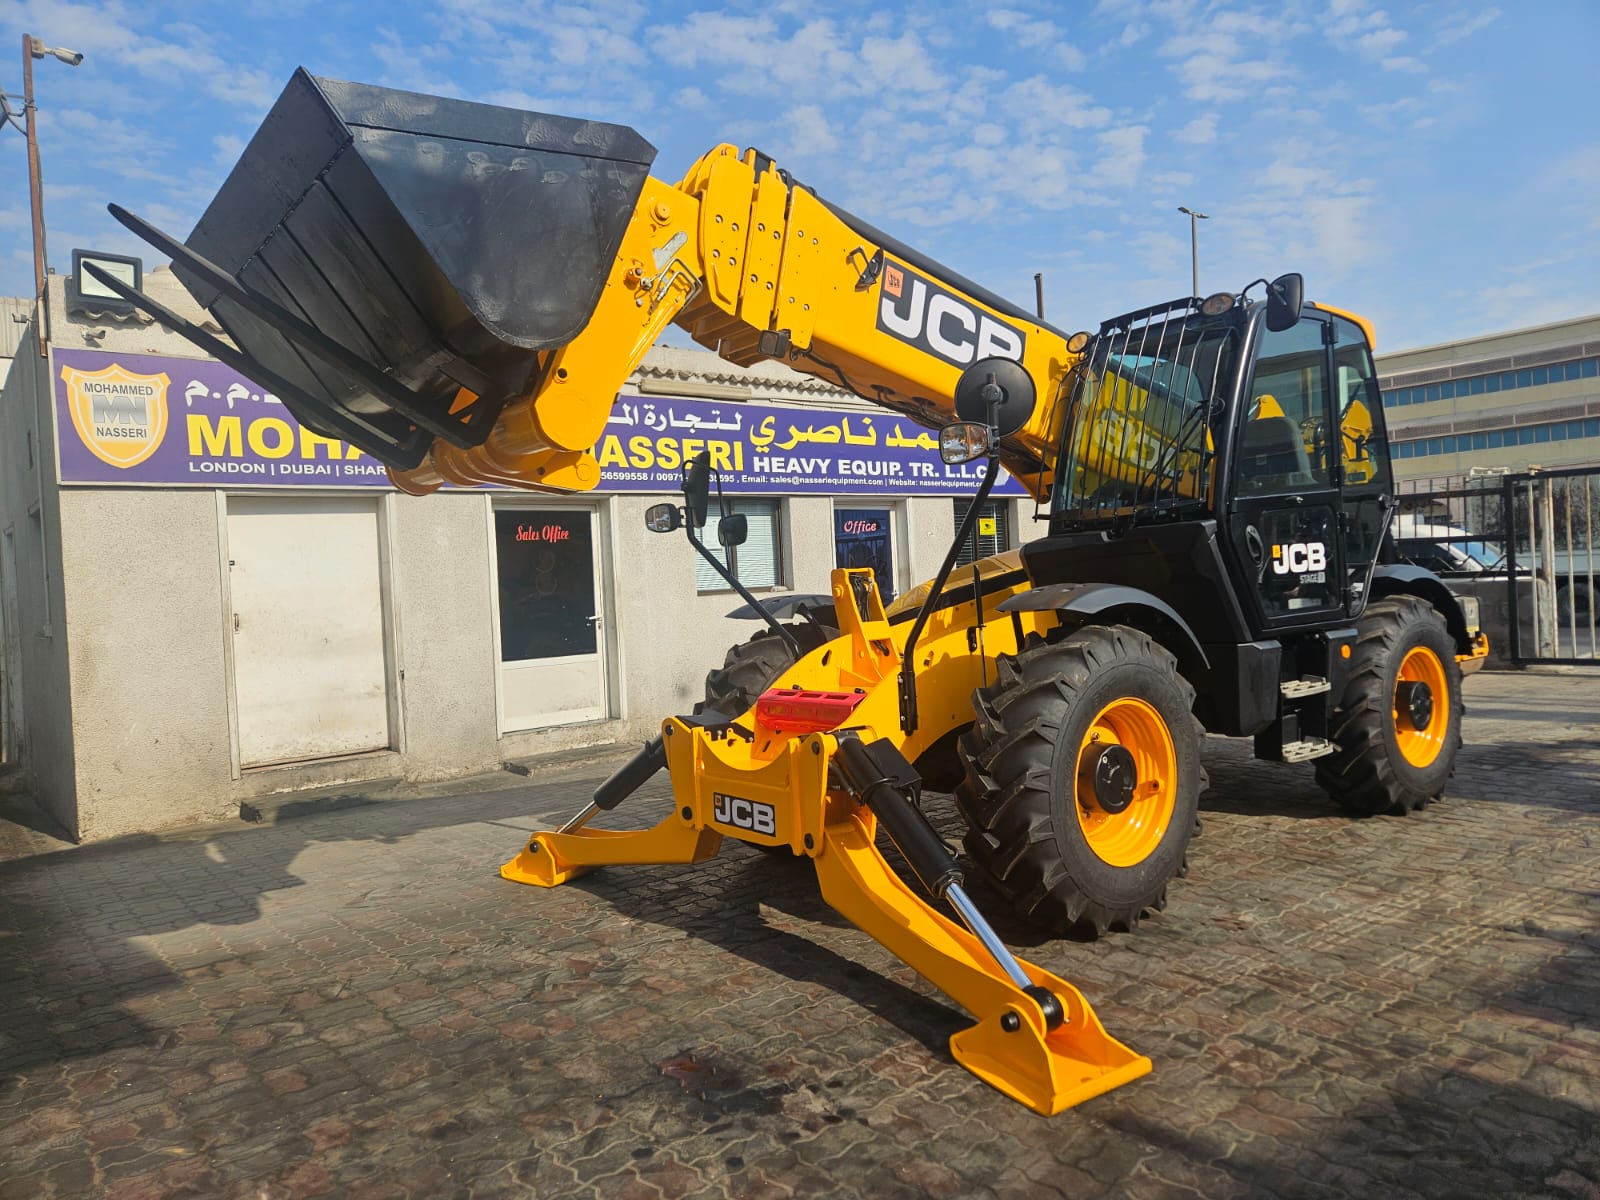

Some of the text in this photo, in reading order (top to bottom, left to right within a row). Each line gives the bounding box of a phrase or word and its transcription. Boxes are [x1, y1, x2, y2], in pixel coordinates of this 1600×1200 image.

[84, 382, 153, 396] MOHAMMED
[608, 403, 639, 426] الم
[96, 427, 147, 438] NASSERI
[749, 415, 877, 453] ناصري
[186, 414, 368, 460] MOH
[588, 434, 744, 471] ASSERI
[753, 456, 832, 474] HEAVY
[838, 459, 904, 476] EQUIP.
[909, 462, 940, 477] TR.
[189, 462, 266, 474] LONDON
[280, 465, 331, 475] DUBAI
[344, 465, 387, 475] SHAR
[600, 471, 648, 480] 56599558
[741, 475, 769, 483] Email:
[889, 479, 918, 487] Website:
[516, 525, 569, 543] Sales Office
[843, 520, 877, 535] Office
[1272, 542, 1327, 575] JCB
[714, 796, 775, 834] JCB
